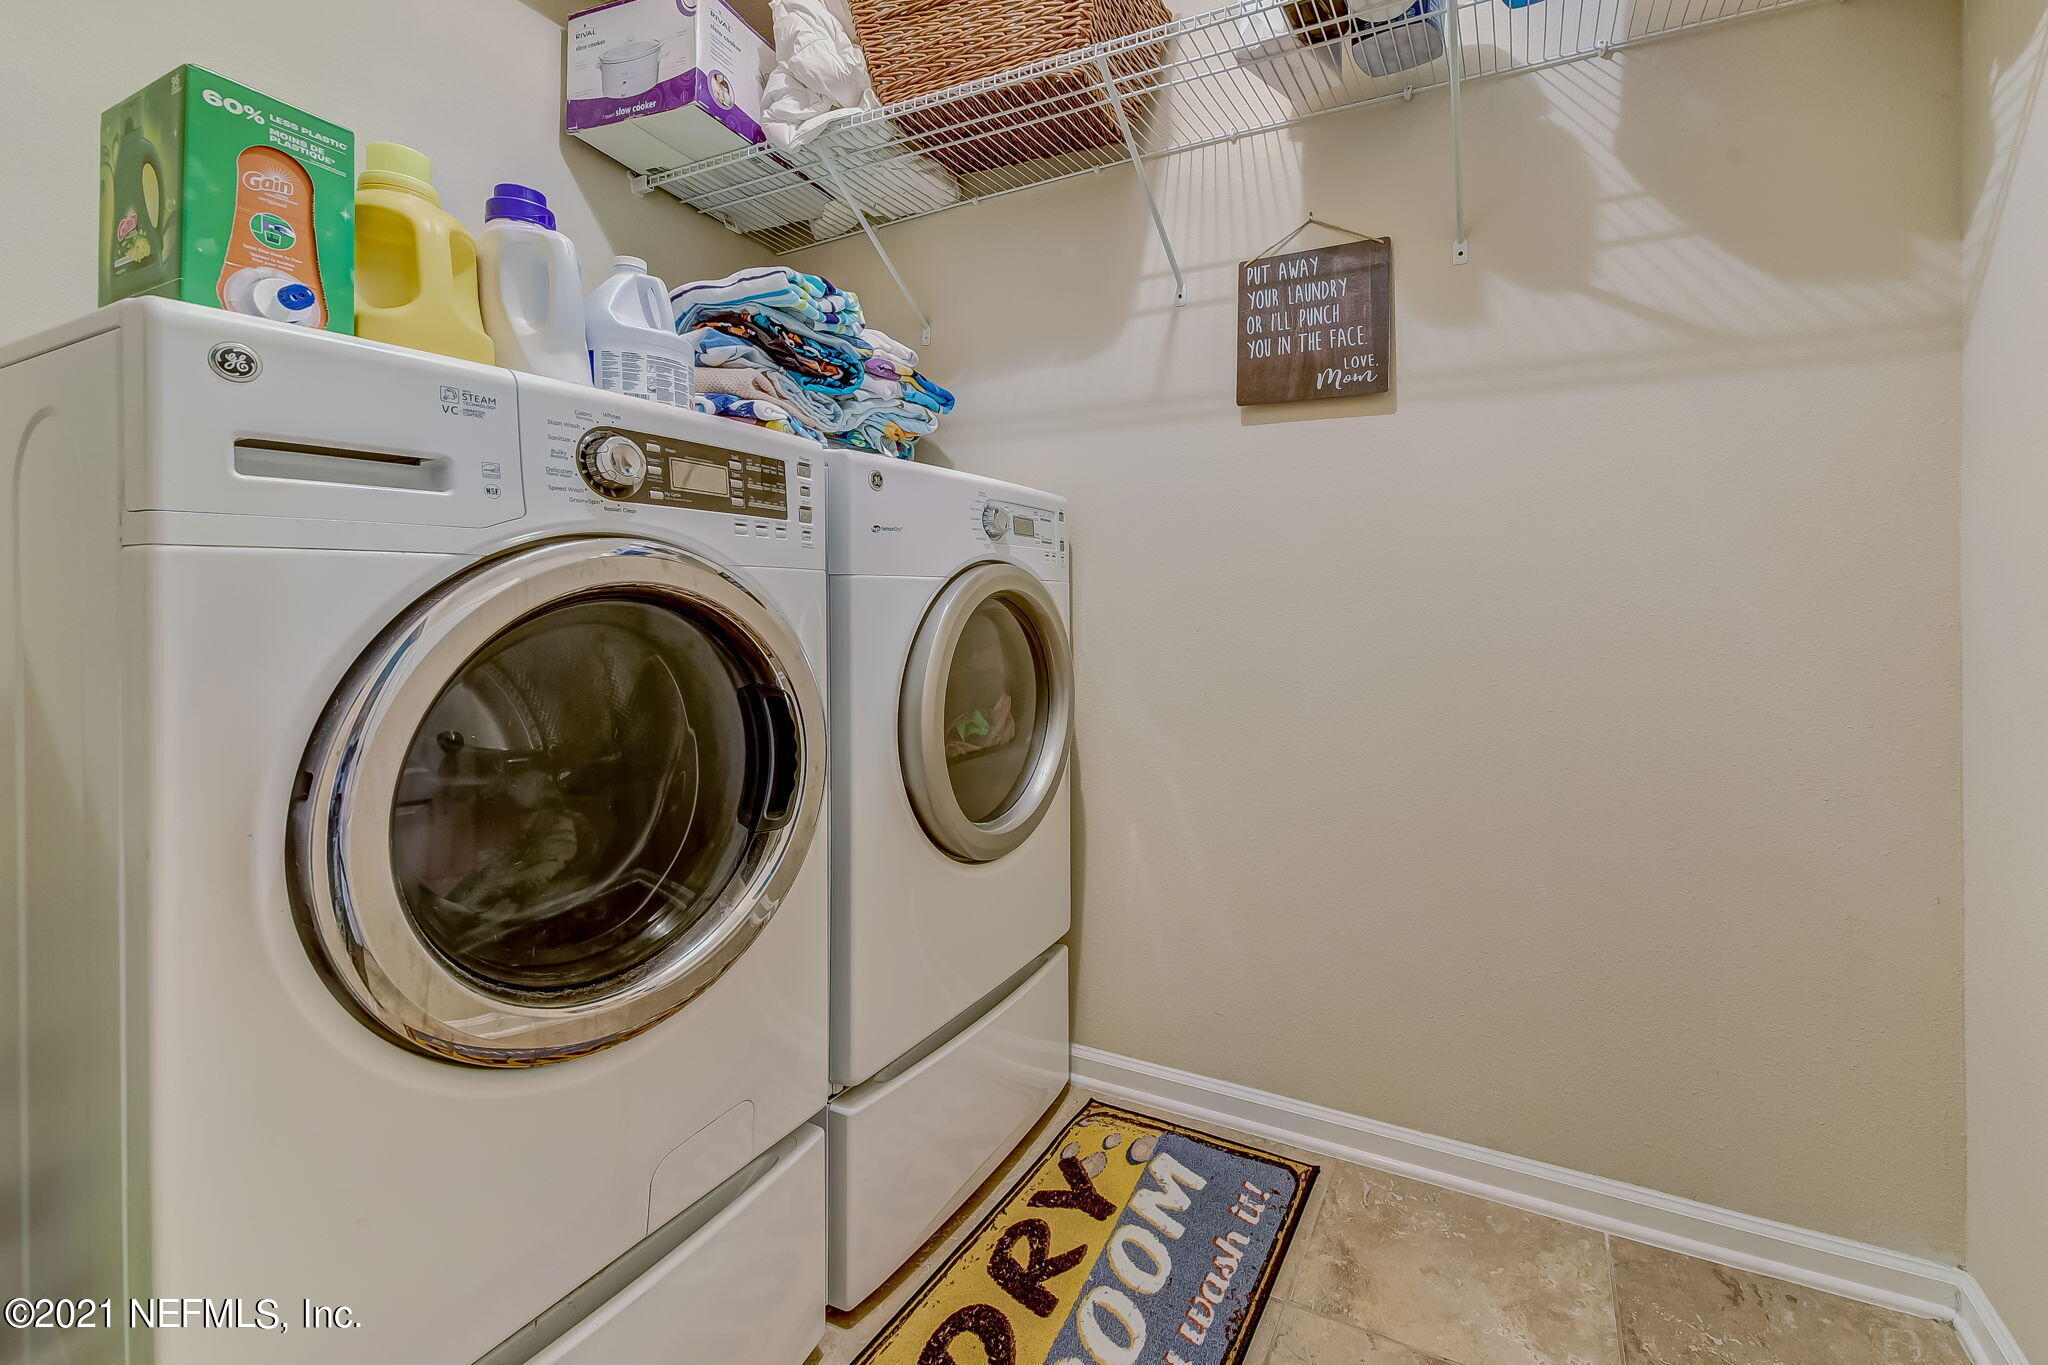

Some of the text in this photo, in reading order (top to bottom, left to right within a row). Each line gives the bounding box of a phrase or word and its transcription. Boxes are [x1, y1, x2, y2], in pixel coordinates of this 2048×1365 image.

[710, 10, 733, 34] RIVAL
[575, 29, 597, 40] RIVAL
[575, 40, 606, 52] slow cooker
[202, 89, 266, 124] 60%
[615, 106, 631, 117] slow
[632, 100, 657, 112] cooker
[269, 113, 299, 131] LESS
[269, 128, 325, 155] MOINS DE
[242, 171, 294, 196] Gain
[1247, 256, 1319, 287] PUT AWAY
[1247, 277, 1347, 310] YOUR LAUNDRY
[1246, 304, 1340, 335] OR I'LL PUNCH
[1247, 325, 1368, 360] YOU IN THE FACE.
[1316, 368, 1378, 390] Mom
[462, 392, 497, 405] STEAM
[441, 404, 459, 415] VC
[574, 409, 592, 418] Colors
[602, 412, 621, 420] Whites
[546, 418, 581, 429] Stain Wash
[550, 448, 568, 456] Bulky
[545, 466, 573, 475] Delicates
[547, 484, 567, 492] Speed
